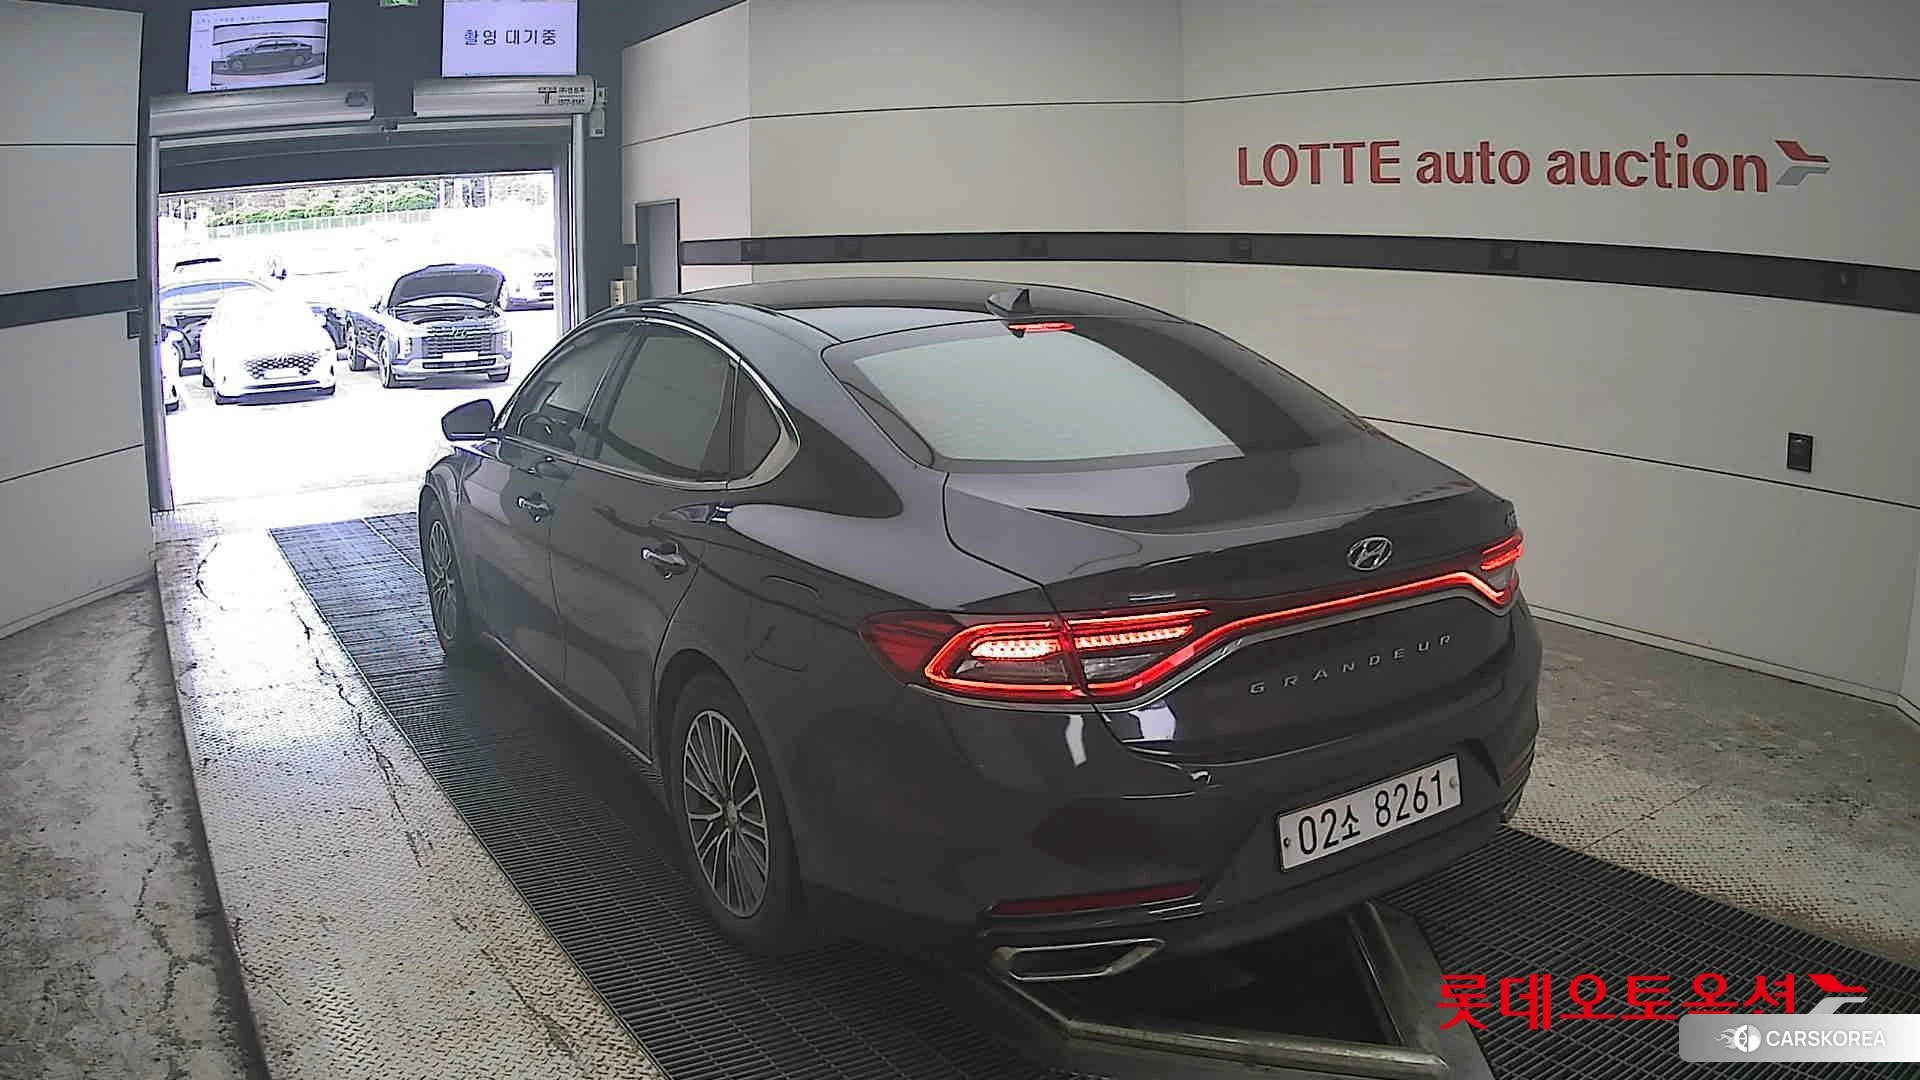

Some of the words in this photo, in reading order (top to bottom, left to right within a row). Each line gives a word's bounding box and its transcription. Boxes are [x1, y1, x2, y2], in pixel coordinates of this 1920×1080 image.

[505, 29, 557, 46] 대기중
[1237, 140, 1400, 187] LOTTE
[1416, 141, 1531, 186] auto
[1546, 133, 1769, 193] auction
[1249, 633, 1452, 694] GRANDEUR
[1298, 804, 1361, 855] 02소
[1374, 769, 1443, 828] 8261
